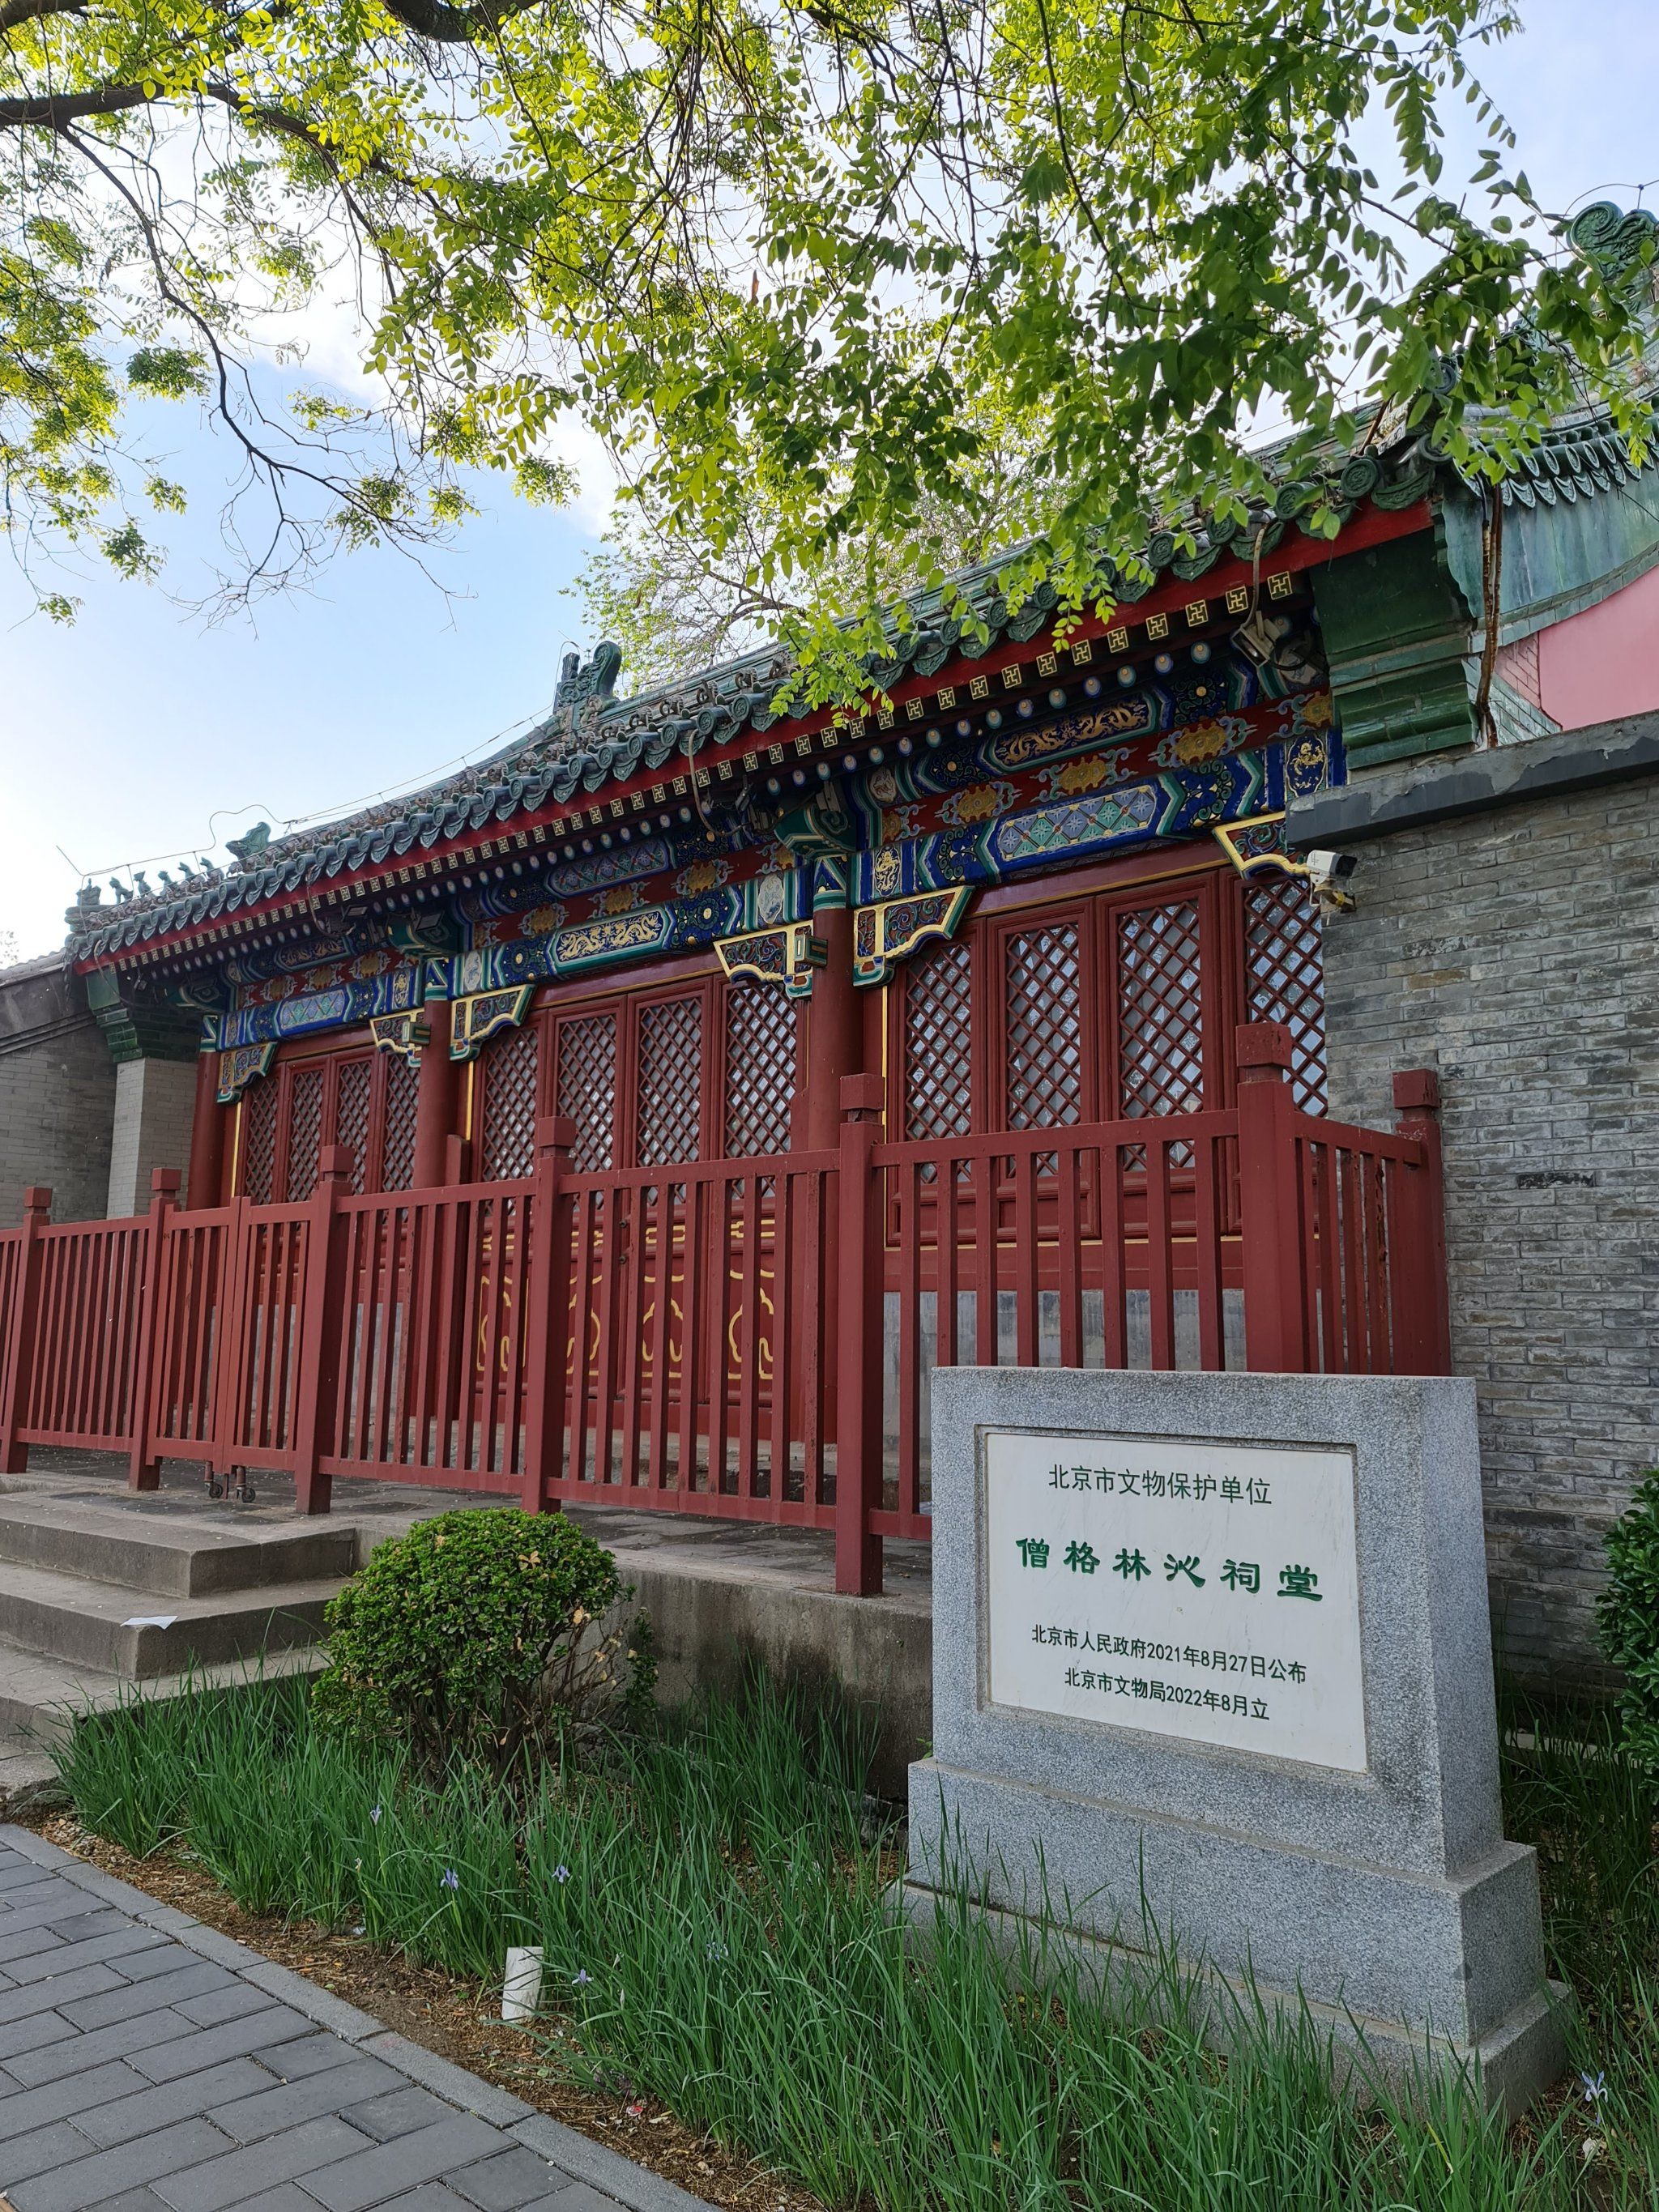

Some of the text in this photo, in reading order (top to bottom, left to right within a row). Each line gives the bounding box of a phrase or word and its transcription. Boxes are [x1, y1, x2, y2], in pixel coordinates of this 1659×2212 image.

[1048, 1464, 1272, 1506] 北京市文物保护单位
[1015, 1537, 1324, 1602] 僧格林沁祠堂
[1031, 1623, 1307, 1685] 北京市人民政府2021年8月27日公布
[1064, 1667, 1270, 1720] 北京市文物局2022年8月立
